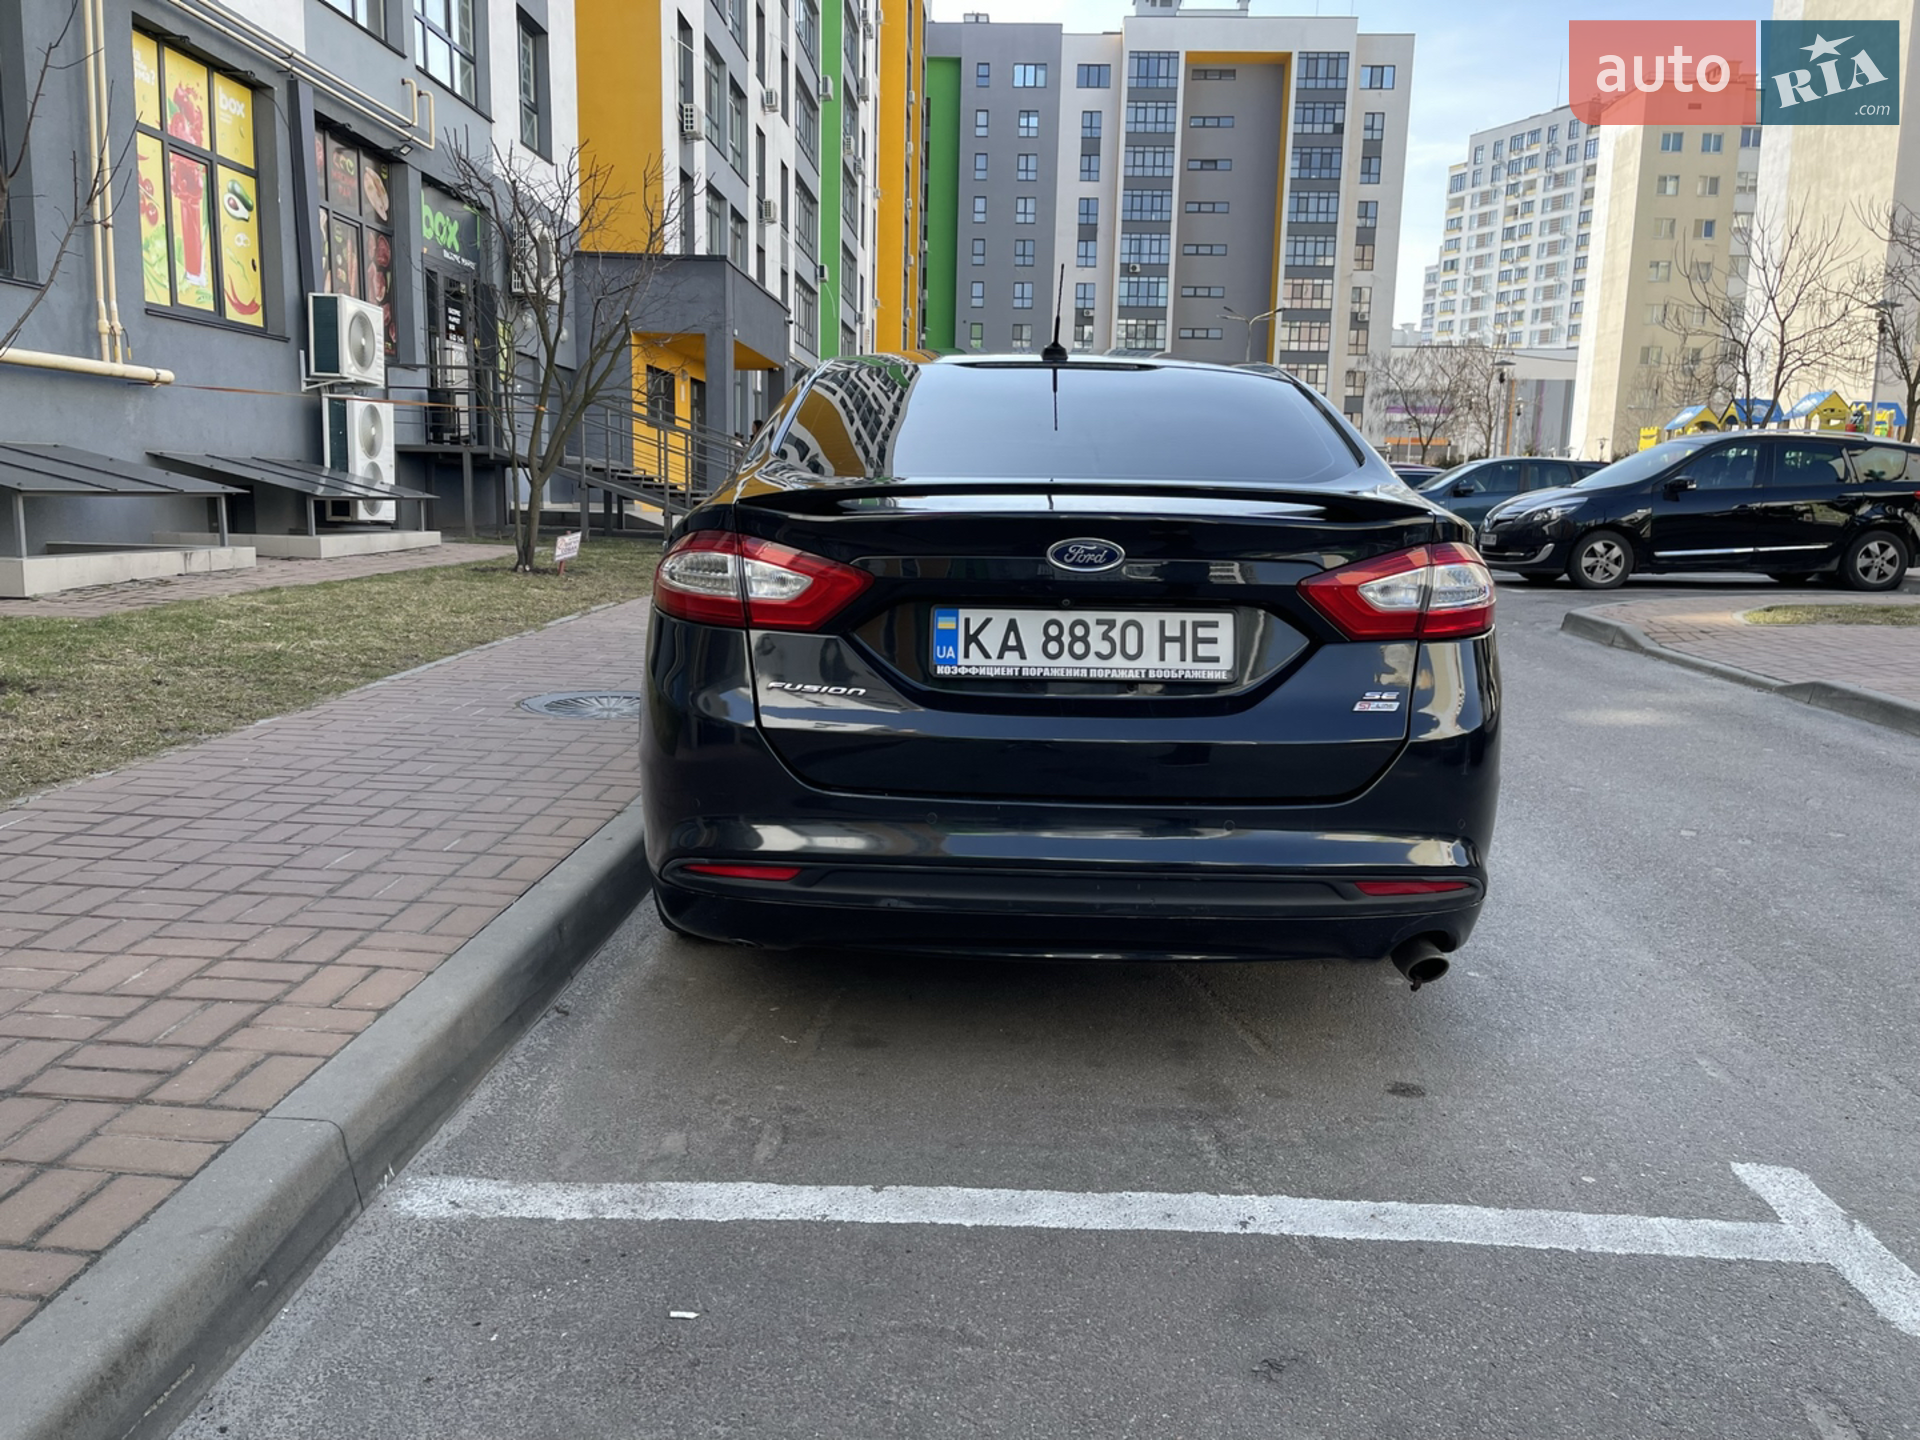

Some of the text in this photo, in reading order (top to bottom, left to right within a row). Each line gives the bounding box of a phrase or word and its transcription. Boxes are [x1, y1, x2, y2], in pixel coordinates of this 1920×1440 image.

[219, 85, 245, 118] box
[421, 188, 459, 252] box
[1063, 544, 1108, 563] Ford
[963, 616, 1221, 663] KA 8830 HE
[936, 645, 956, 659] UA
[936, 665, 1228, 680] КОЭФФИЦИЕНТ ПОРАЖЕНИЯ ПОРАЖАЕТ ВООБРАЖЕНИЕ
[766, 681, 867, 697] FUSION
[1362, 691, 1400, 700] SE
